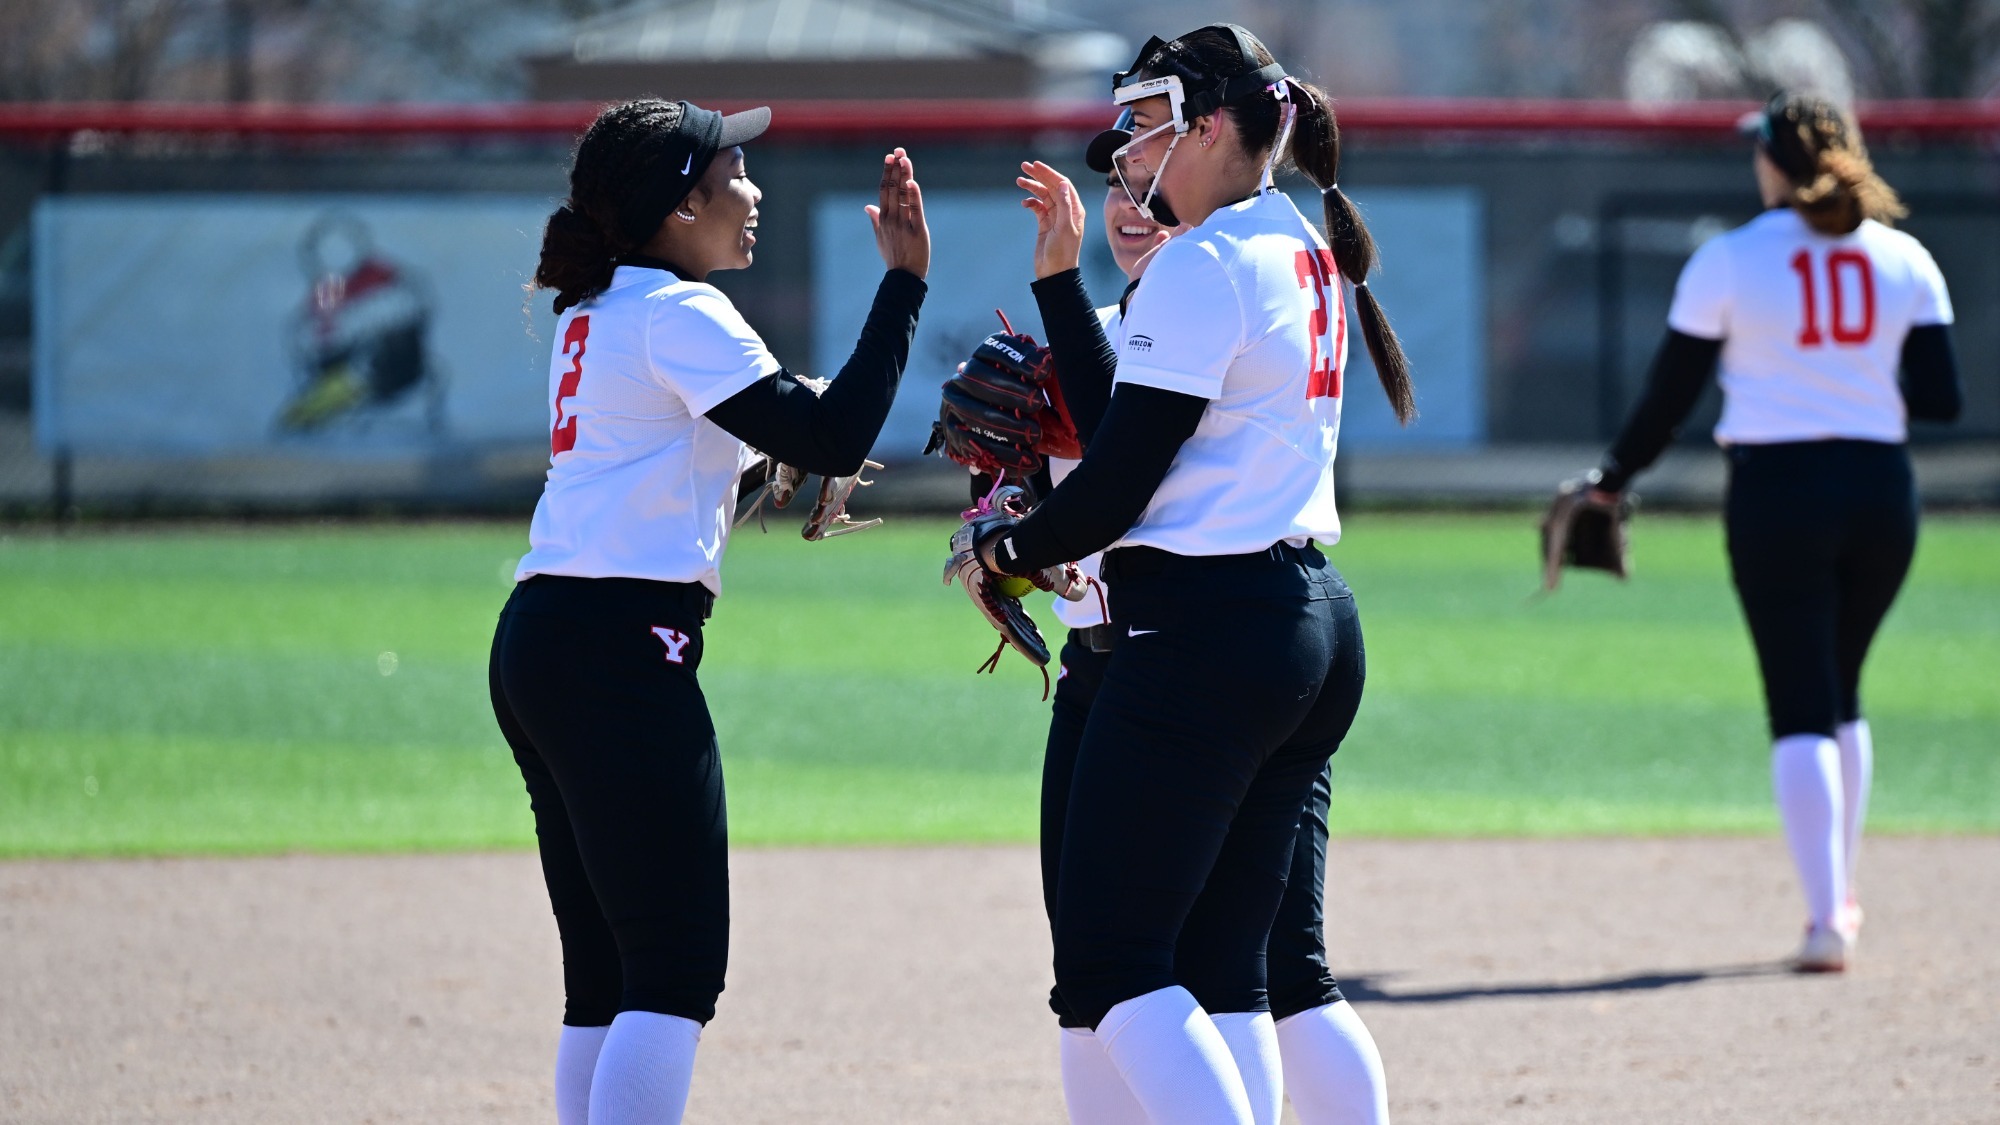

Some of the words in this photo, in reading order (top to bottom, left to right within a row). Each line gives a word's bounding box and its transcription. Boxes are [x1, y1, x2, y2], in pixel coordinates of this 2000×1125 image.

[1790, 248, 1875, 345] 10
[984, 337, 1025, 363] EASTON
[1129, 340, 1152, 348] HORIZON
[552, 315, 590, 457] 2
[650, 625, 690, 664] Y
